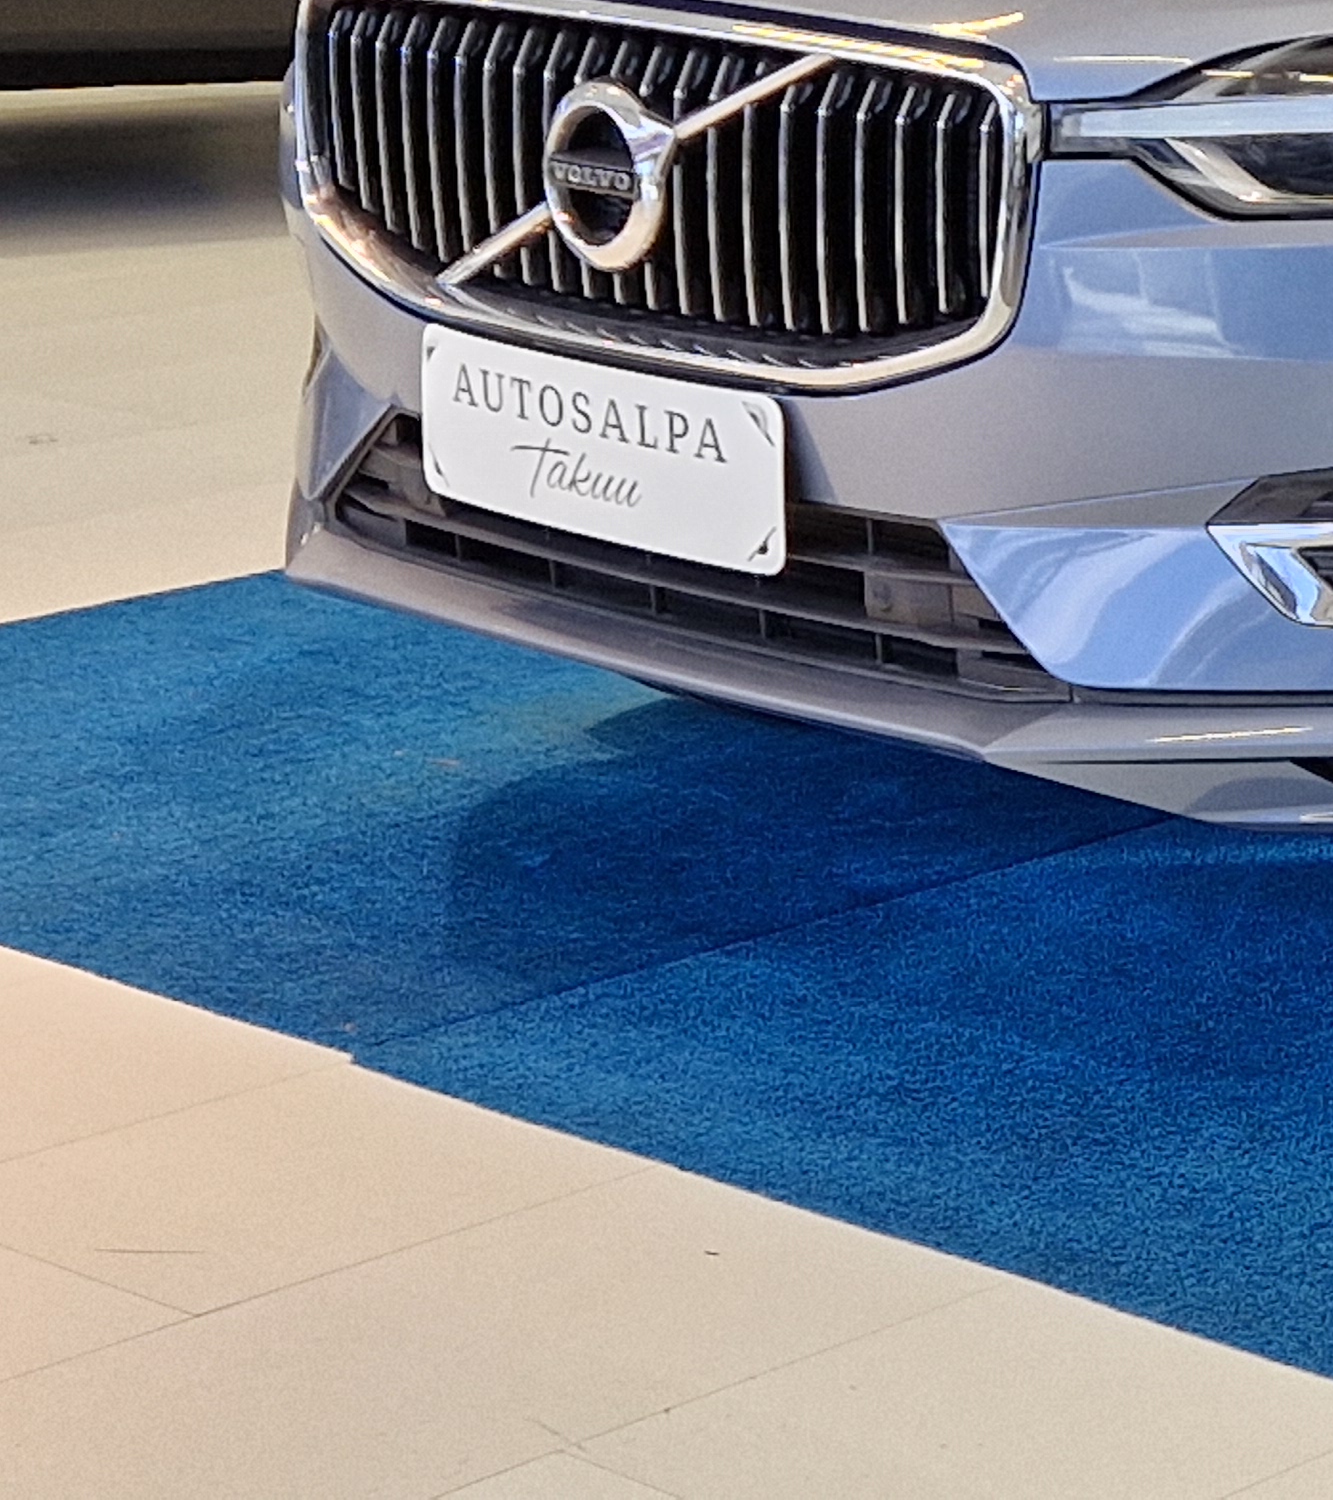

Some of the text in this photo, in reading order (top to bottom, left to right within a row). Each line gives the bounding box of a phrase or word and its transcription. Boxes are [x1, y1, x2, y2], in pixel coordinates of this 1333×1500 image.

[552, 161, 632, 191] VOLVO
[453, 363, 728, 463] AUTOSALPA
[510, 438, 643, 508] Takuu
